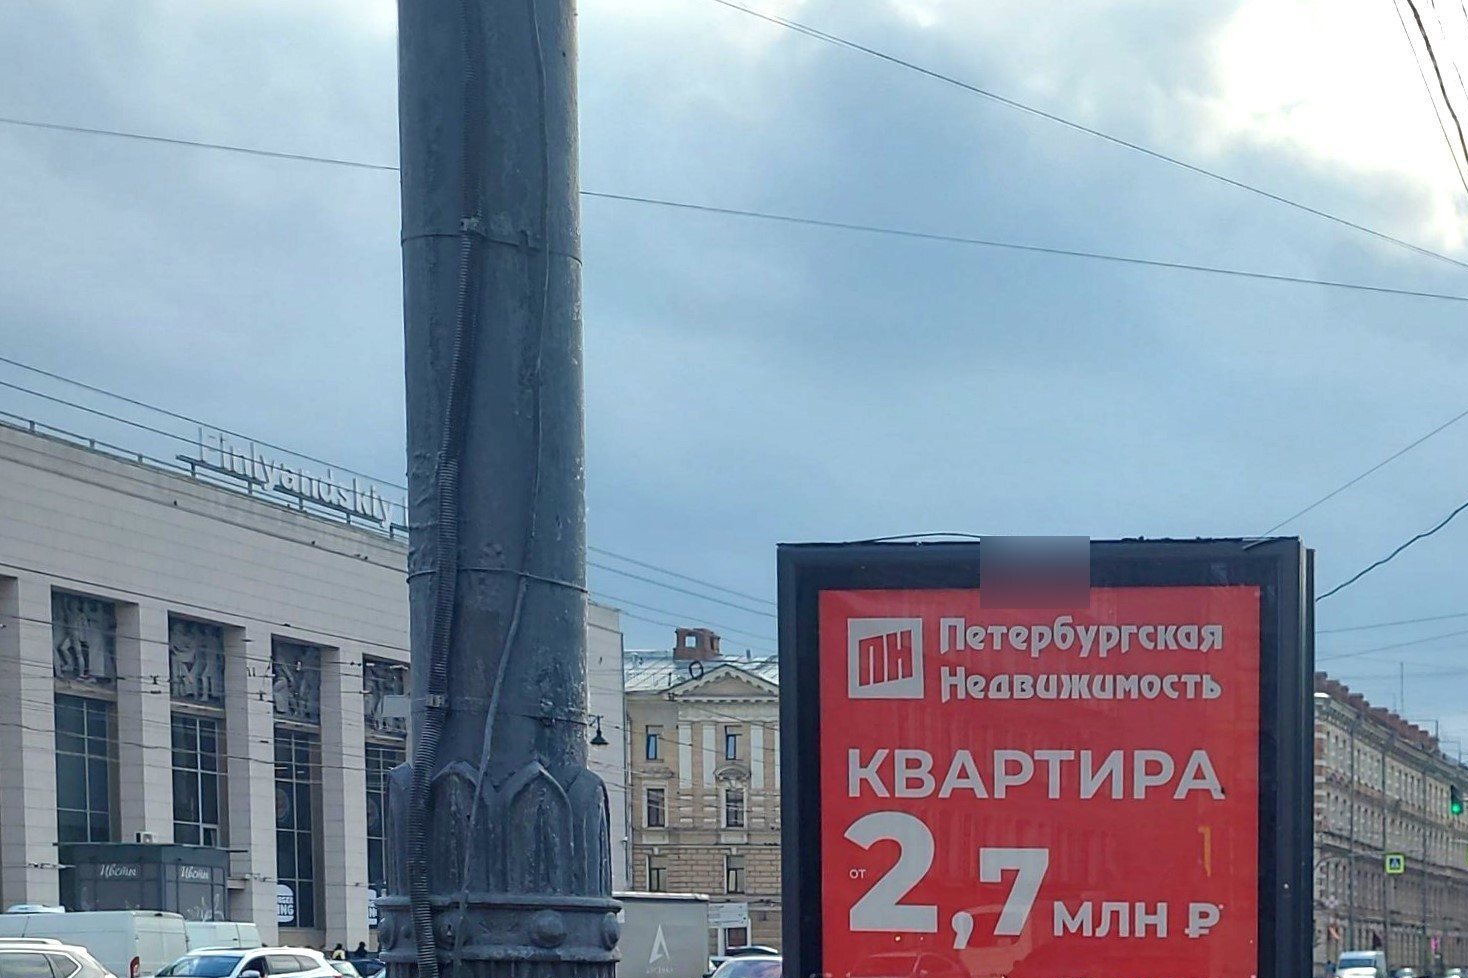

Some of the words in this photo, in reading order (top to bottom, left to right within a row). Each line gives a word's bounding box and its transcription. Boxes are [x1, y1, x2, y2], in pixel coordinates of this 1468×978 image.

[940, 615, 1223, 657] Петербургская
[940, 666, 1222, 703] Недвижимость
[848, 748, 1226, 800] КВАРТИРА
[844, 811, 1049, 950] 2,7
[1053, 901, 1168, 938] МЛН
[849, 869, 866, 879] от
